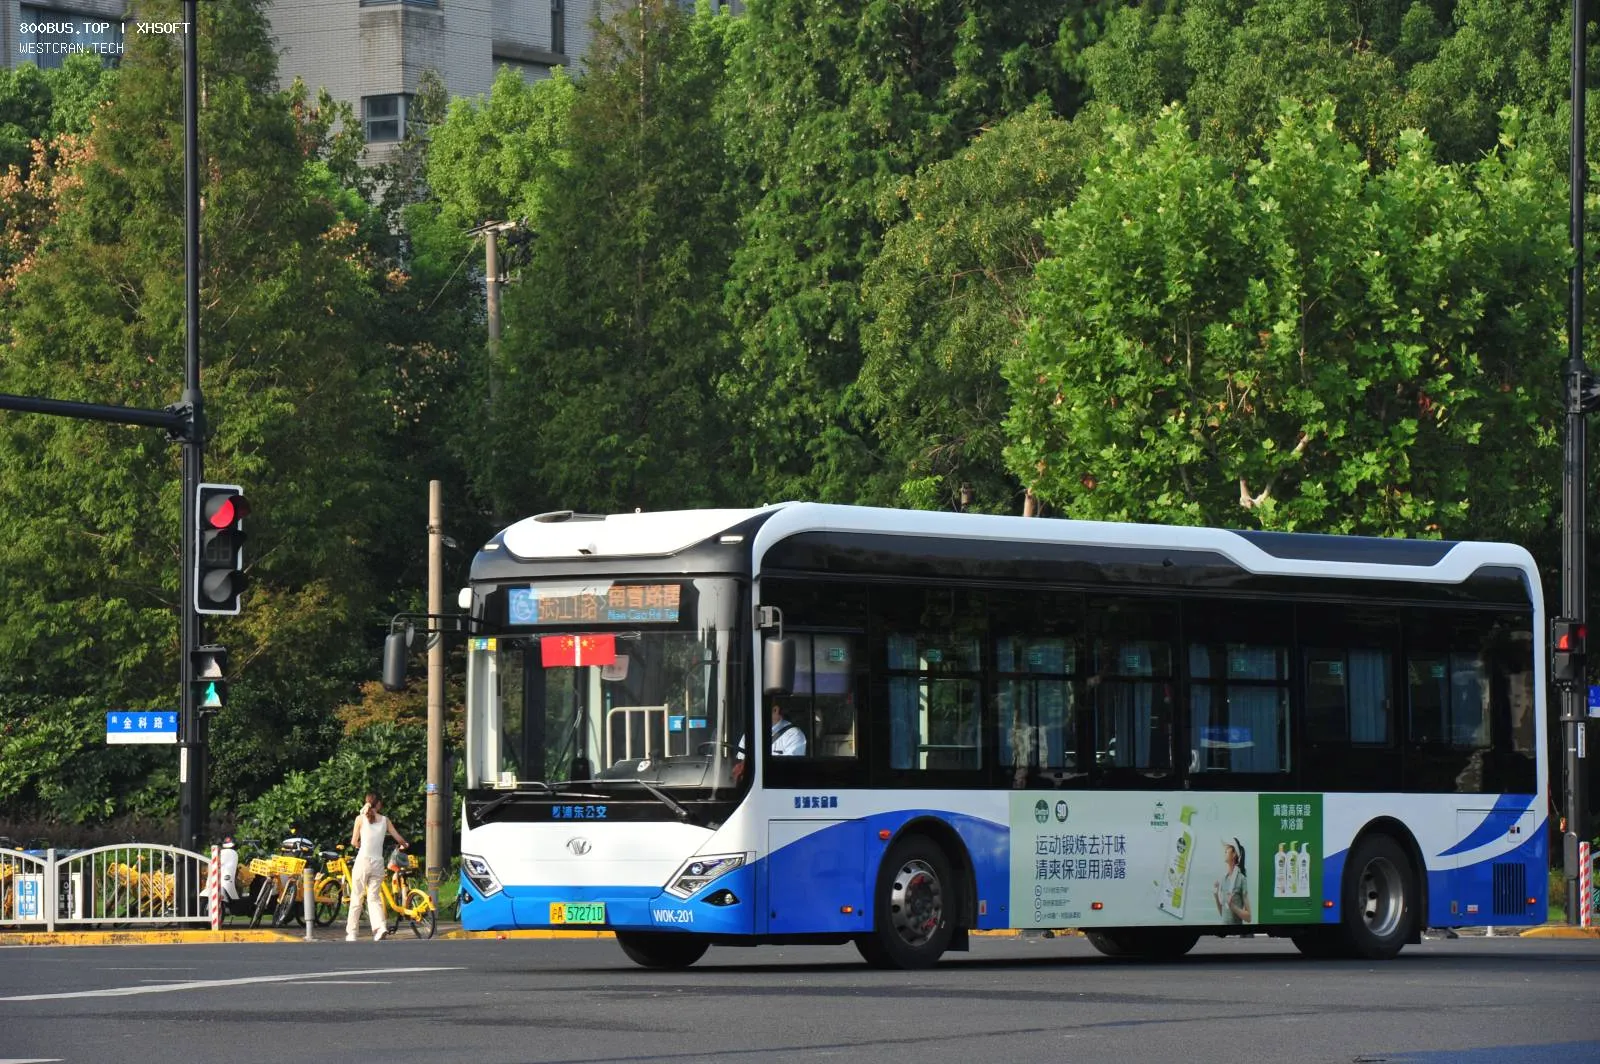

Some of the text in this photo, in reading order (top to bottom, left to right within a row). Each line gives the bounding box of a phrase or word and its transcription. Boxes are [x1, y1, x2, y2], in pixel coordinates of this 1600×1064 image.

[123, 716, 163, 730] 金科路
[562, 805, 607, 818] 浦东公交
[1273, 804, 1311, 817] 滴露高保湿
[1280, 818, 1304, 831] 沐浴露
[1035, 834, 1126, 855] 运动锻炼去汗味
[1035, 859, 1126, 880] 清爽保湿用滴露
